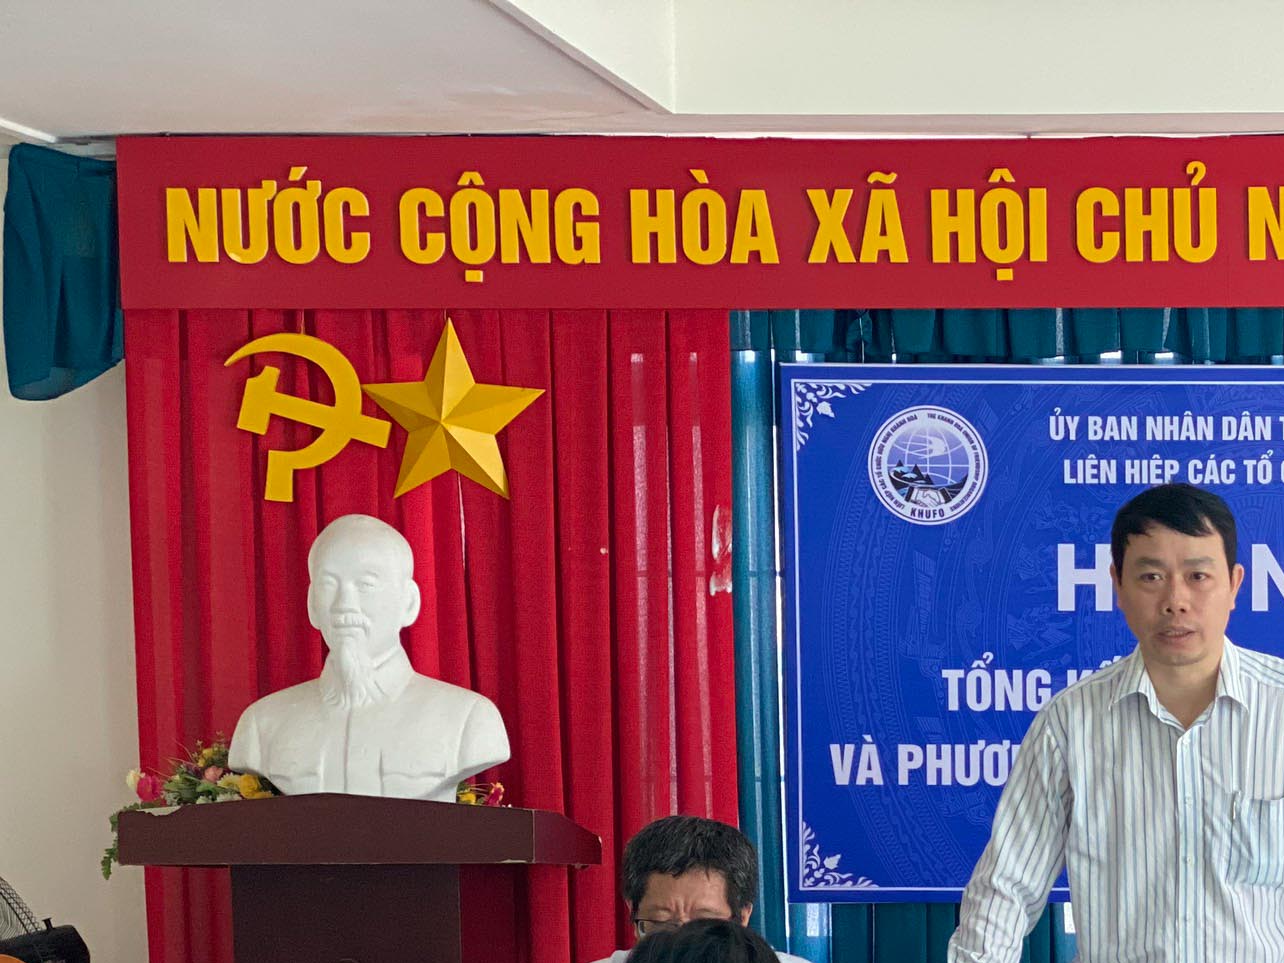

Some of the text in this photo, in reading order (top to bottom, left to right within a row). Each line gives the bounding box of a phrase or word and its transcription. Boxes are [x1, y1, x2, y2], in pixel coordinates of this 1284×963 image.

[167, 167, 370, 263] NƯỚC
[400, 172, 600, 282] CỘNG
[631, 170, 779, 264] HÒA
[807, 172, 908, 263] XÃ
[931, 169, 1047, 280] HỘI
[1077, 162, 1217, 262] CHỦ
[1050, 408, 1079, 440] ỦY
[1088, 416, 1137, 440] BAN
[1147, 411, 1213, 440] NHÂN
[1223, 411, 1271, 440] DÂN
[1064, 455, 1116, 483] LIÊN
[1188, 455, 1235, 484] CÁC
[1244, 450, 1273, 484] TỔ
[910, 507, 945, 519] KHUFO
[942, 652, 1051, 711] TỔNG
[830, 735, 883, 785] VÀ
[899, 740, 1021, 786] PHƯƠ
